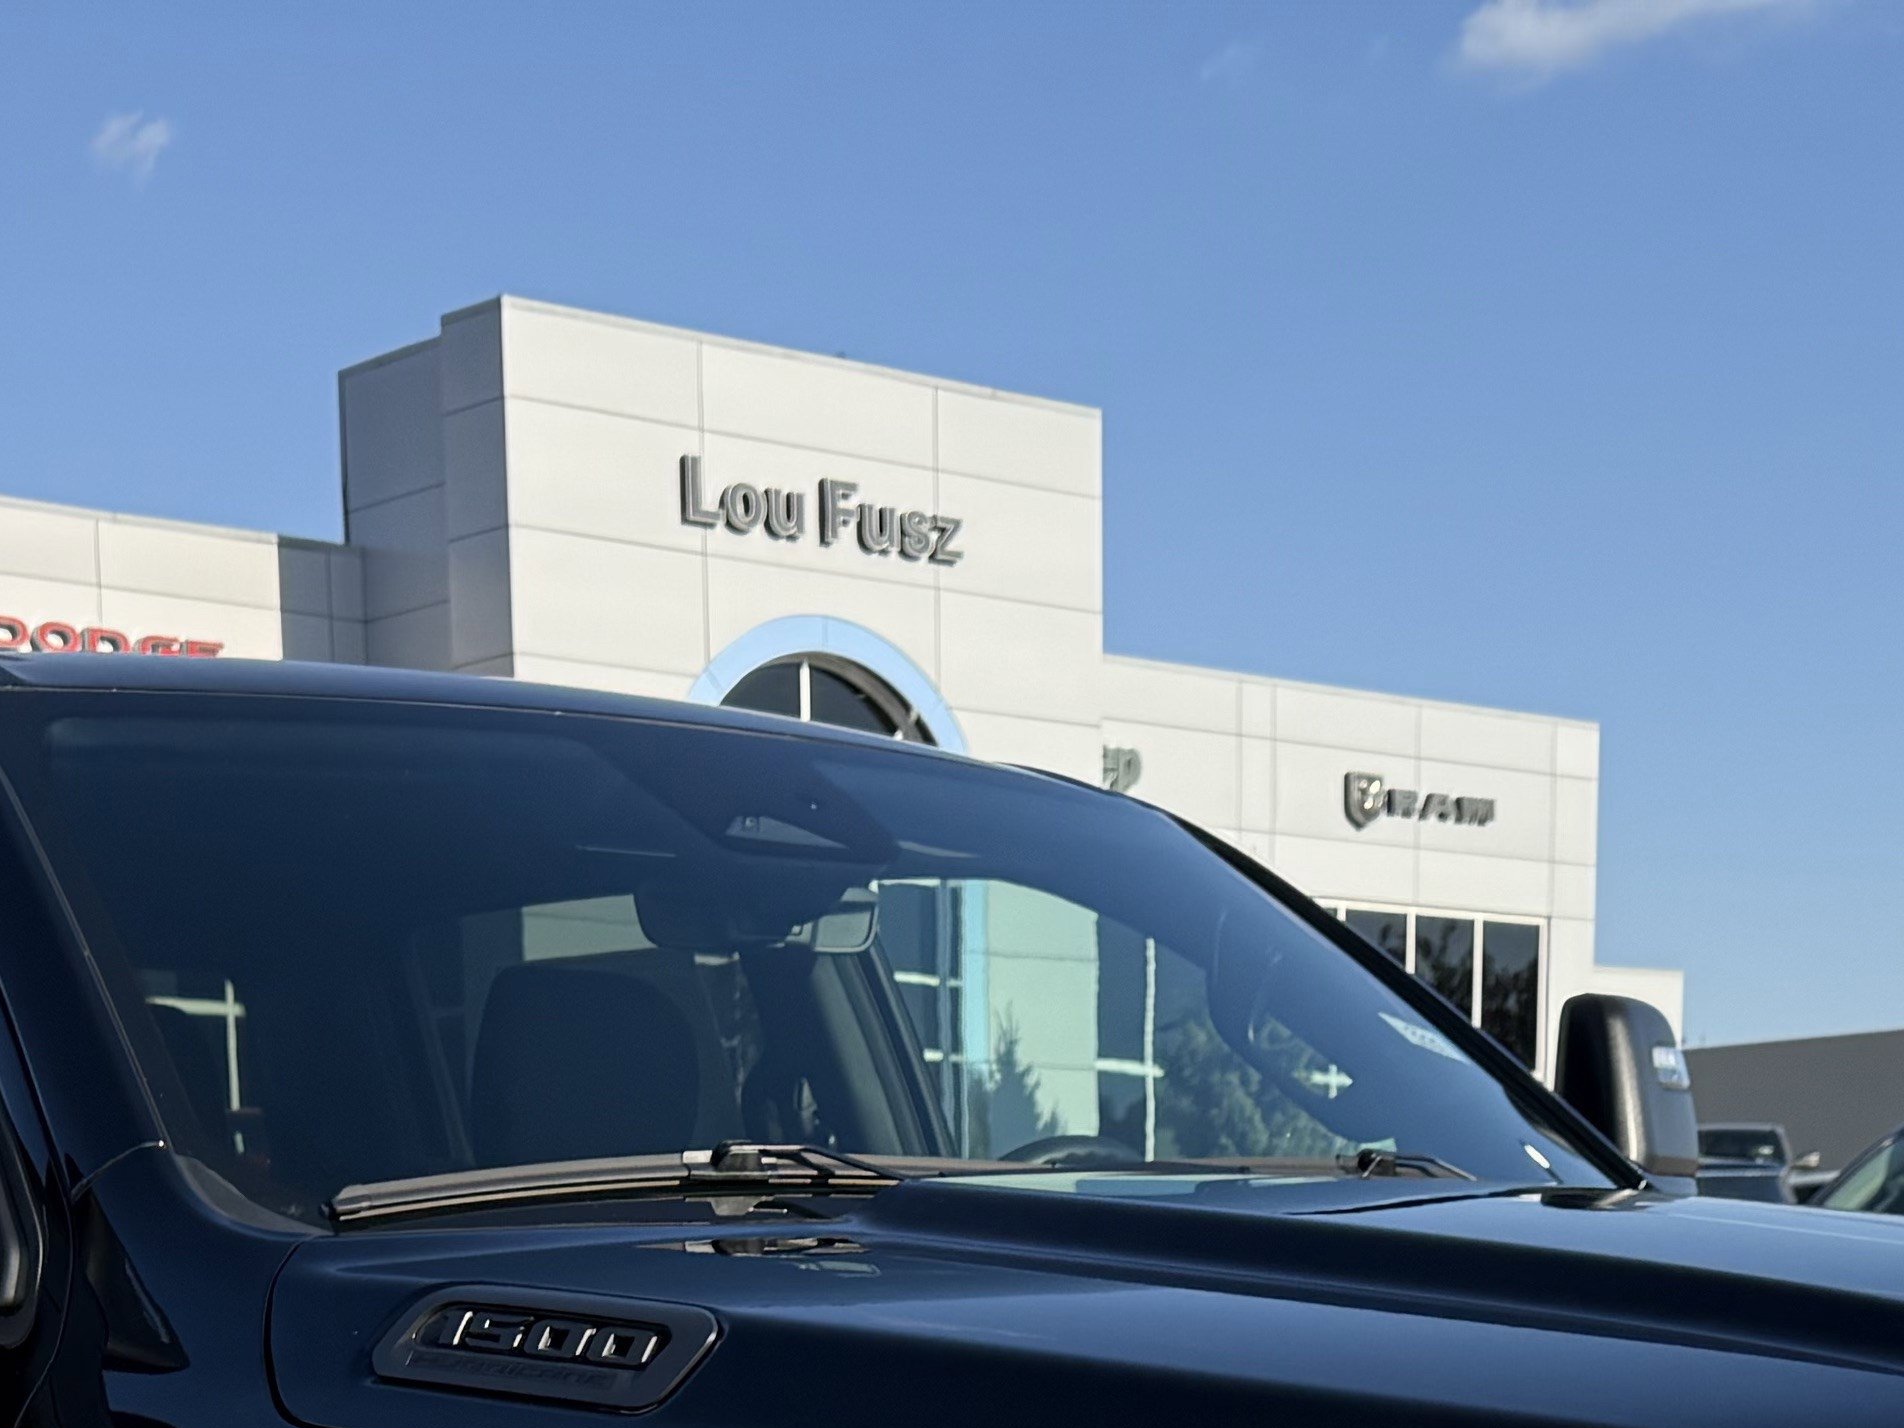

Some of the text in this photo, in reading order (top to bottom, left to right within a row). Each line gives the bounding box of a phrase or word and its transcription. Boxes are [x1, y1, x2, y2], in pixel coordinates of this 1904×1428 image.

[679, 453, 965, 567] Lou Fusz
[1386, 788, 1496, 827] RAM
[439, 1308, 658, 1367] 1500
